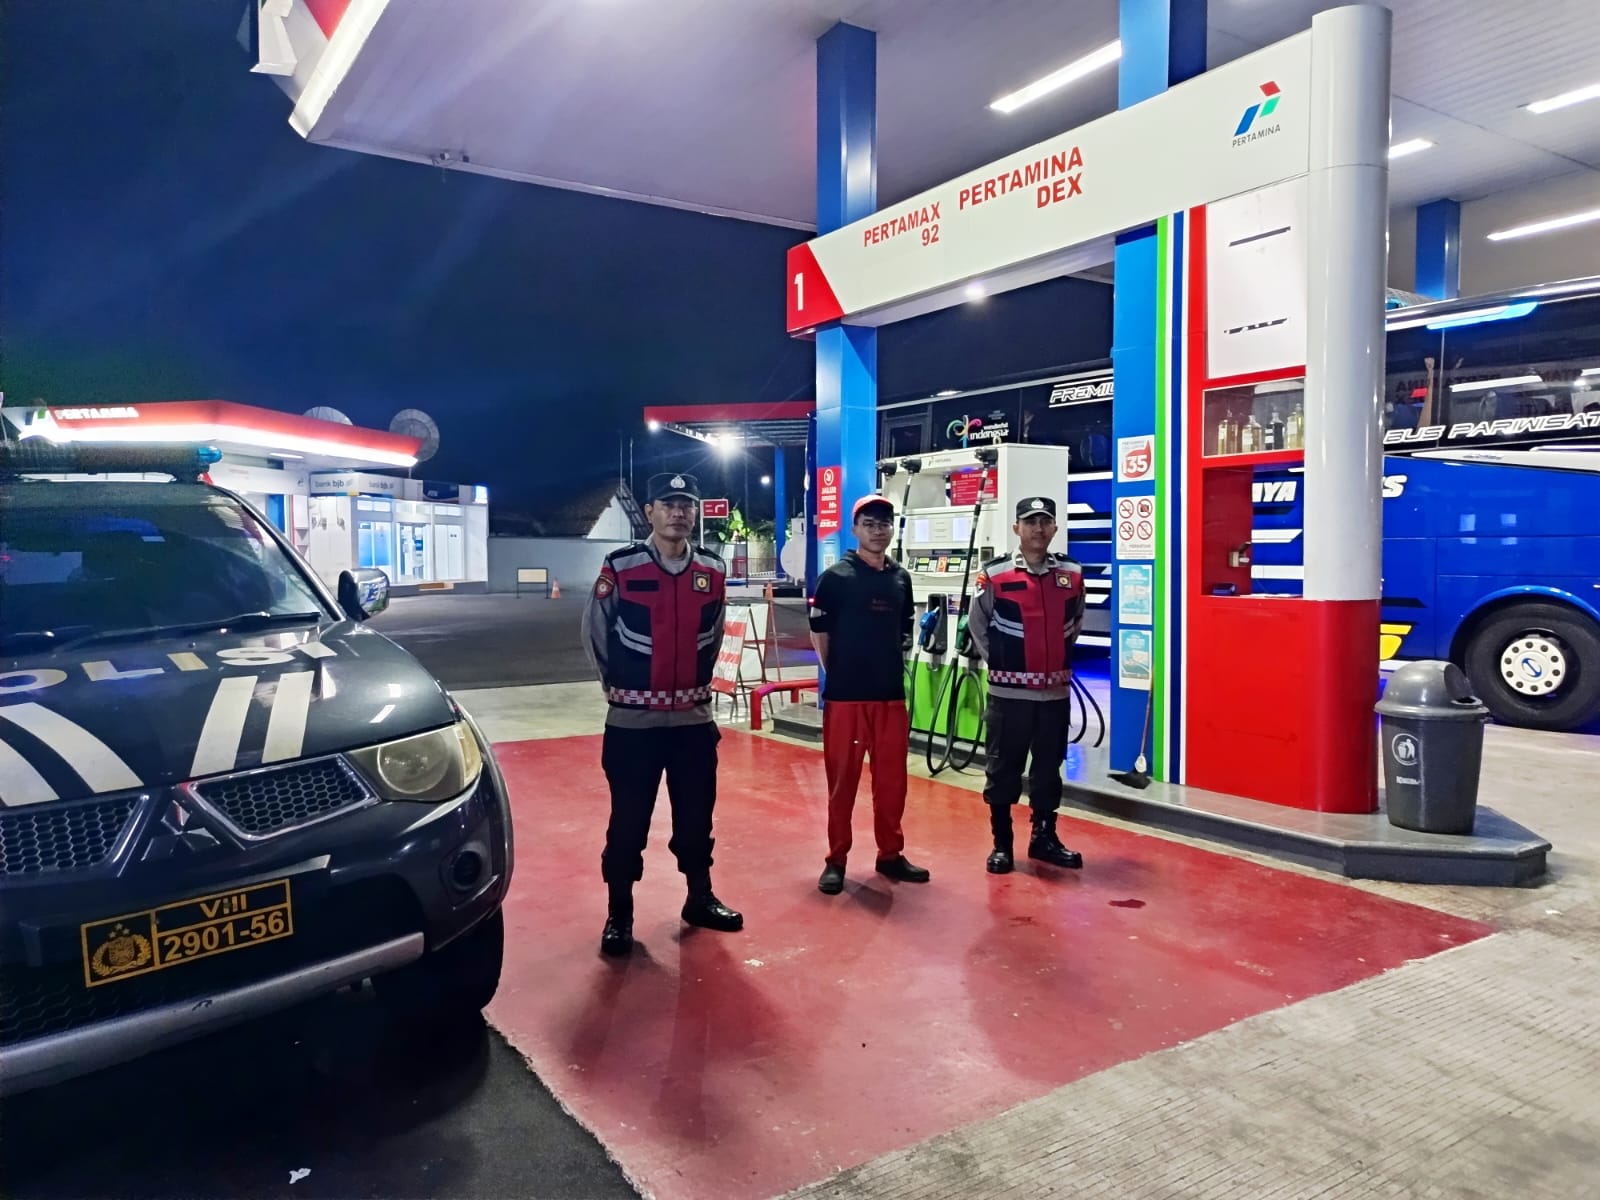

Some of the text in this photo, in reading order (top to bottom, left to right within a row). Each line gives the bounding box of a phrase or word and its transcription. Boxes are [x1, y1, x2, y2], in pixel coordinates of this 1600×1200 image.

[1232, 124, 1281, 148] PERTAMINA
[959, 146, 1084, 210] PERTAMINA
[1036, 172, 1083, 209] DEX
[863, 201, 941, 248] PERTAMAX
[921, 224, 940, 248] 92
[793, 272, 804, 311] 1
[1383, 425, 1447, 445] BUS
[332, 480, 345, 489] bjb
[163, 912, 285, 961] 2901-56
